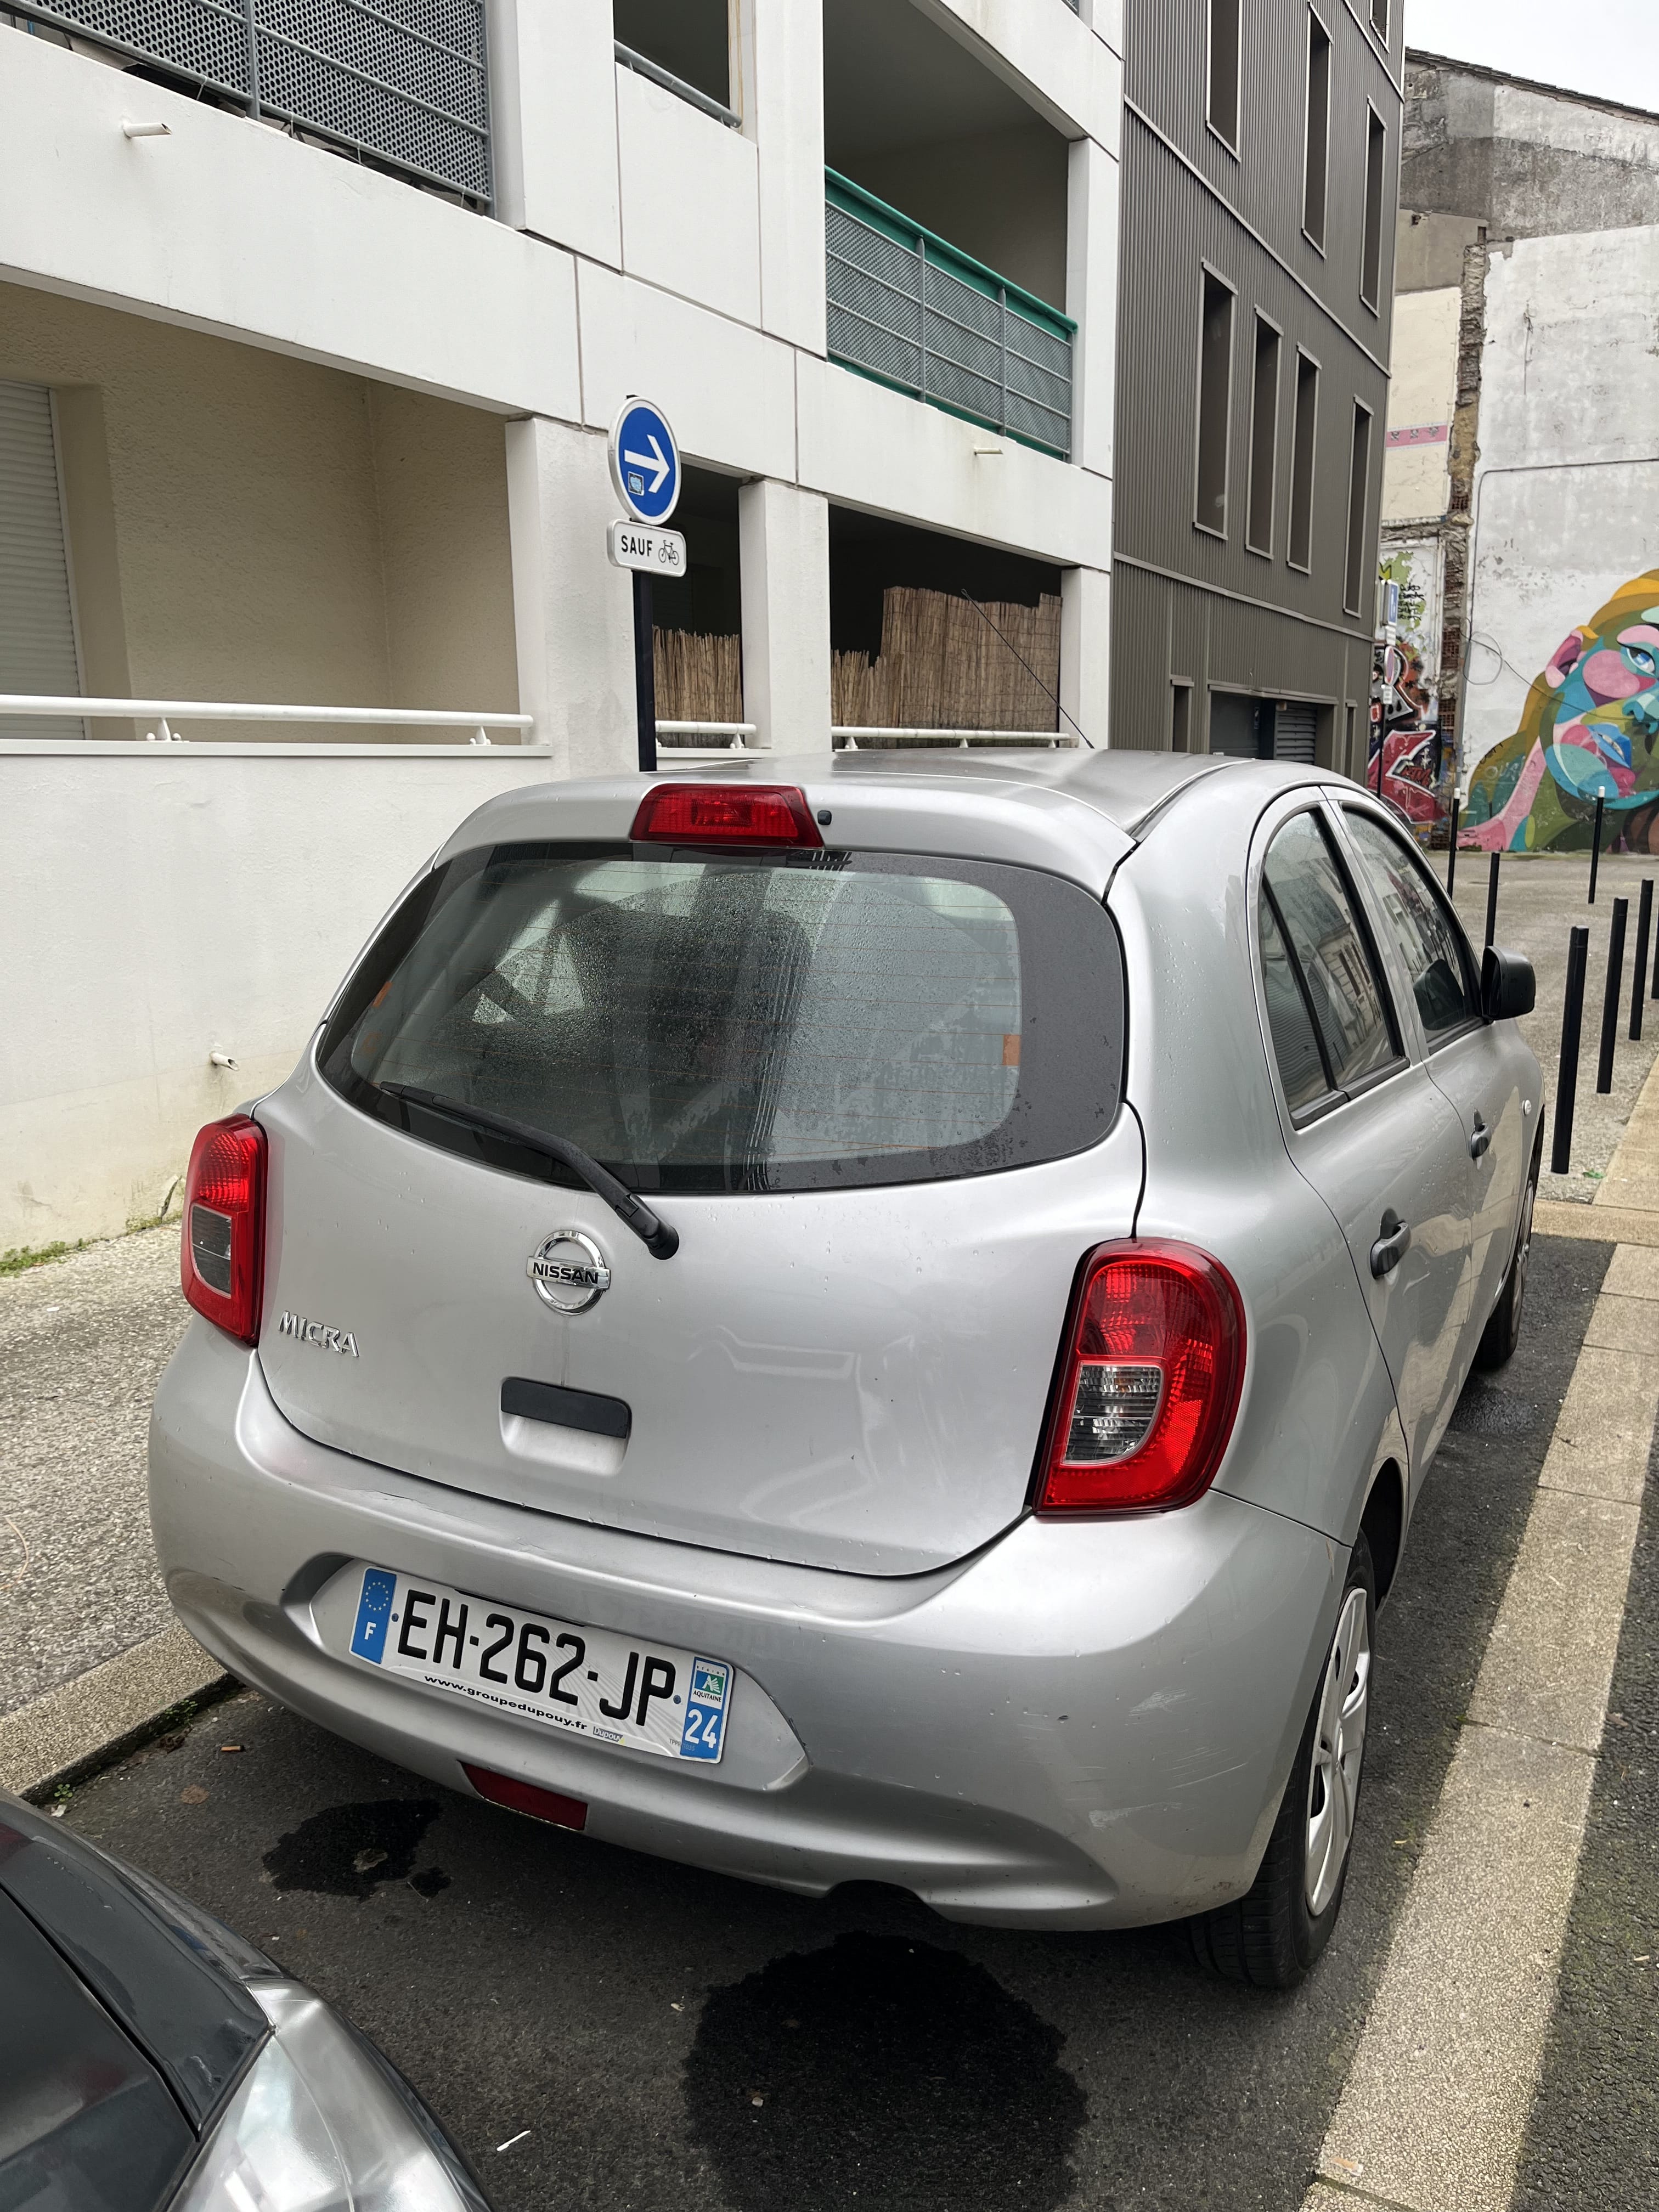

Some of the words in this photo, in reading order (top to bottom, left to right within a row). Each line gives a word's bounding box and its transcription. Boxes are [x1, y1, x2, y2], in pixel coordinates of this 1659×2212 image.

[621, 535, 652, 557] SAUF
[533, 1262, 599, 1284] NISSAN
[278, 1310, 359, 1357] MICRA
[365, 1622, 376, 1640] F
[398, 1589, 675, 1726] EH-262-JP
[424, 1675, 587, 1730] www.groupedupouy.fr
[693, 1690, 721, 1702] AQUITAINE
[685, 1709, 718, 1749] 24
